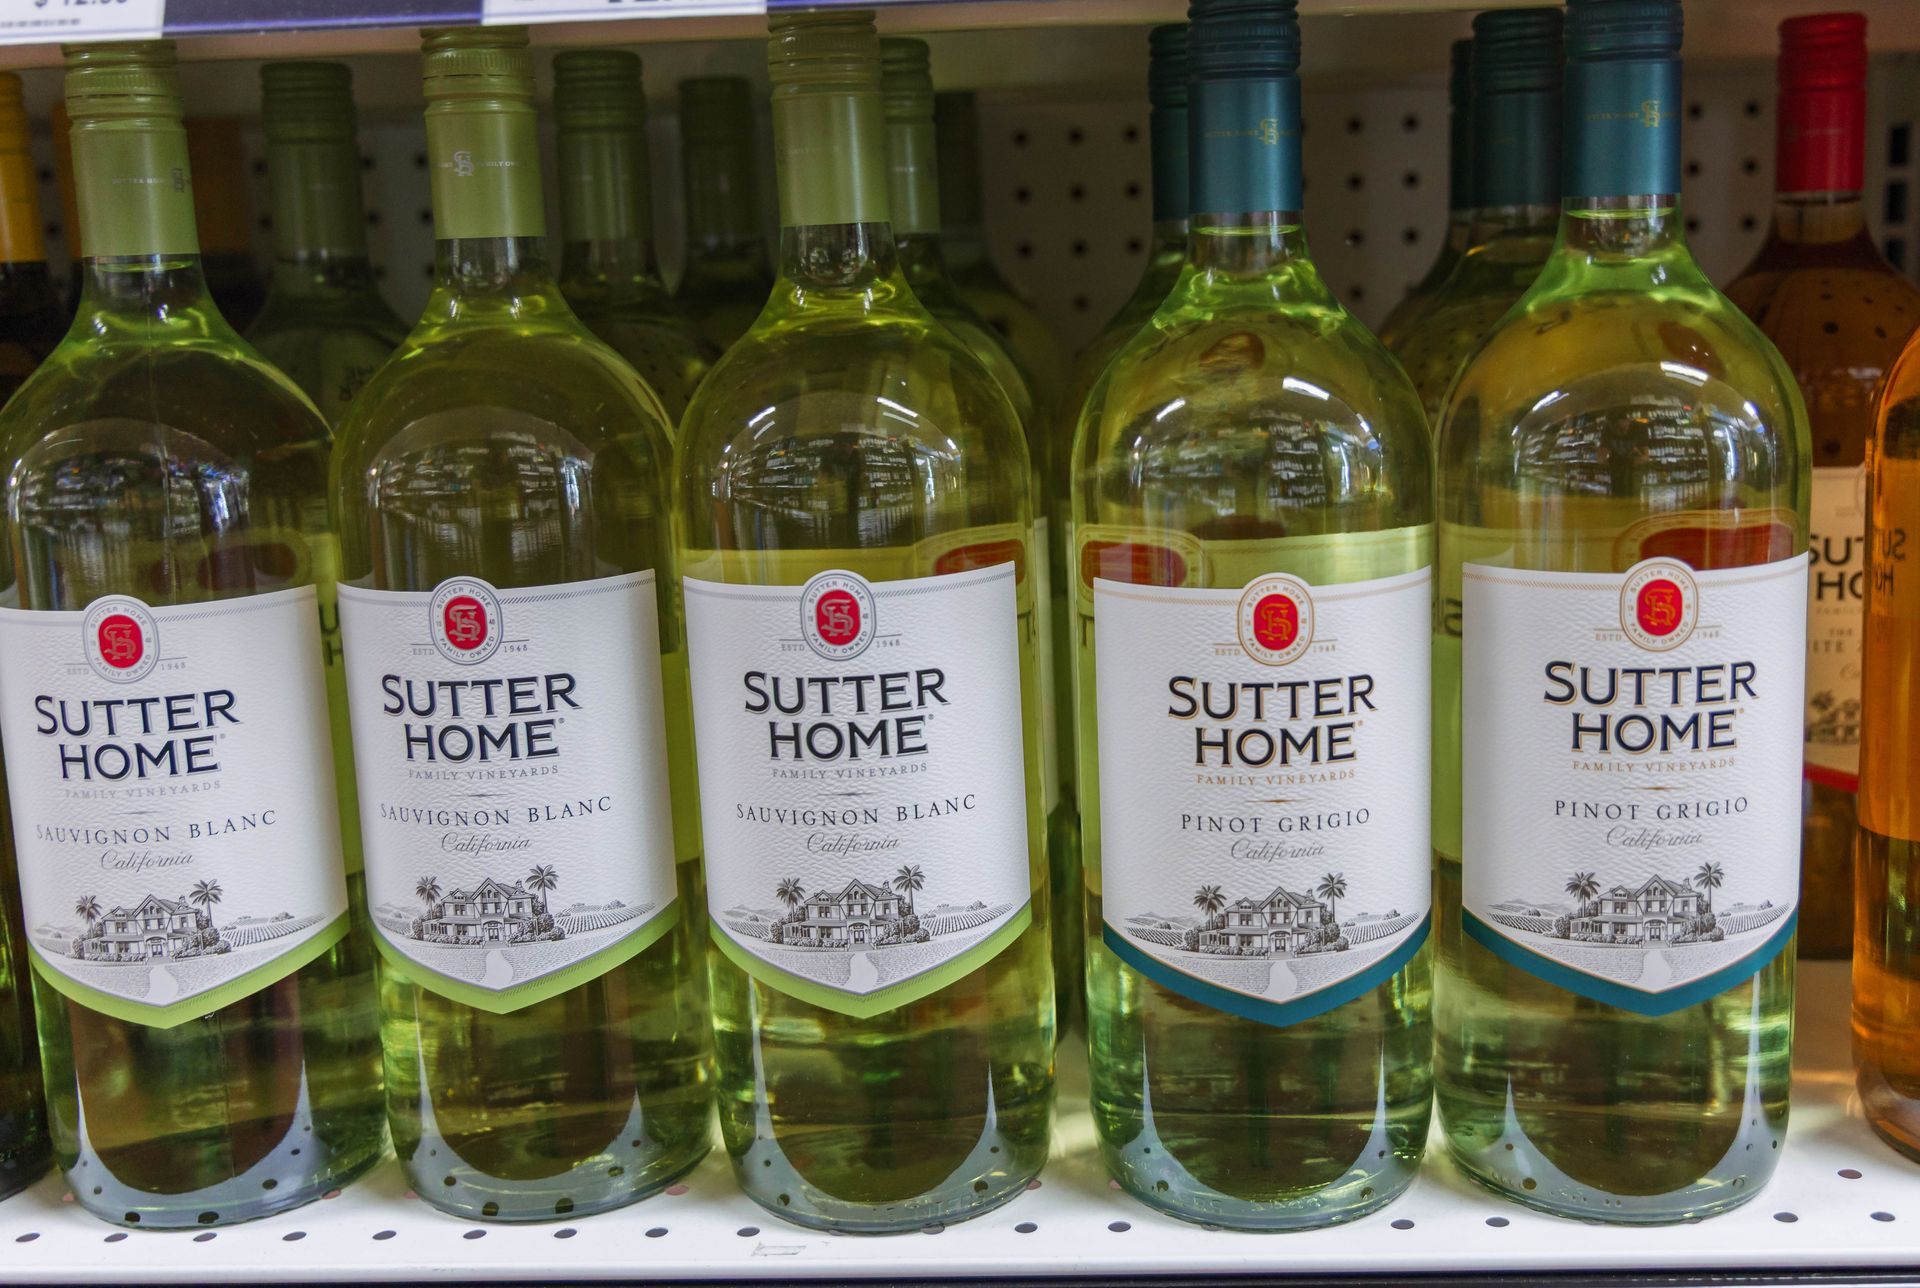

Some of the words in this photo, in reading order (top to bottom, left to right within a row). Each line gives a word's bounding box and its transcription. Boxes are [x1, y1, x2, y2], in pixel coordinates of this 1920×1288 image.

[437, 587, 464, 609] SUTTER
[469, 588, 492, 607] HOME
[808, 581, 838, 604] SUTTER
[843, 582, 865, 601] HOME
[440, 637, 466, 658] FAMILY
[470, 636, 494, 658] OWNED
[503, 644, 528, 653] 1948
[811, 633, 838, 654] FAMILY
[842, 631, 867, 654] OWNED
[876, 639, 900, 648] 1948
[743, 668, 951, 717] SUTTER
[1544, 660, 1759, 708] SUTTER
[381, 673, 583, 719] SUTTER
[1168, 674, 1378, 722] SUTTER
[34, 689, 243, 737] SUTTER
[408, 769, 458, 780] FAMILY
[467, 765, 559, 780] VINEYARDS
[772, 768, 826, 779] FAMILY
[836, 763, 928, 778] VINEYARDS
[1573, 760, 1634, 772] FAMILY
[1645, 757, 1735, 772] VINEYARDS
[1196, 774, 1256, 785] FAMILY
[1266, 769, 1356, 785] VINEYARDS
[65, 790, 117, 800] FAMILY
[125, 781, 222, 798] VINEYARDS
[380, 803, 510, 826] SAUVIGNON
[528, 796, 612, 823] BLANC
[736, 803, 878, 826] SAUVIGNON
[896, 794, 976, 822] BLANC
[1555, 800, 1639, 820] PINOT
[1656, 797, 1748, 820] GRIGIO
[36, 824, 170, 845] SAUVIGNON
[189, 809, 277, 838] BLANC
[1181, 814, 1262, 833] PINOT
[1278, 808, 1370, 832] GRIGIO
[441, 832, 533, 856] California
[806, 832, 899, 857] California
[1606, 826, 1702, 850] California
[101, 850, 194, 872] California
[1231, 838, 1325, 863] California
